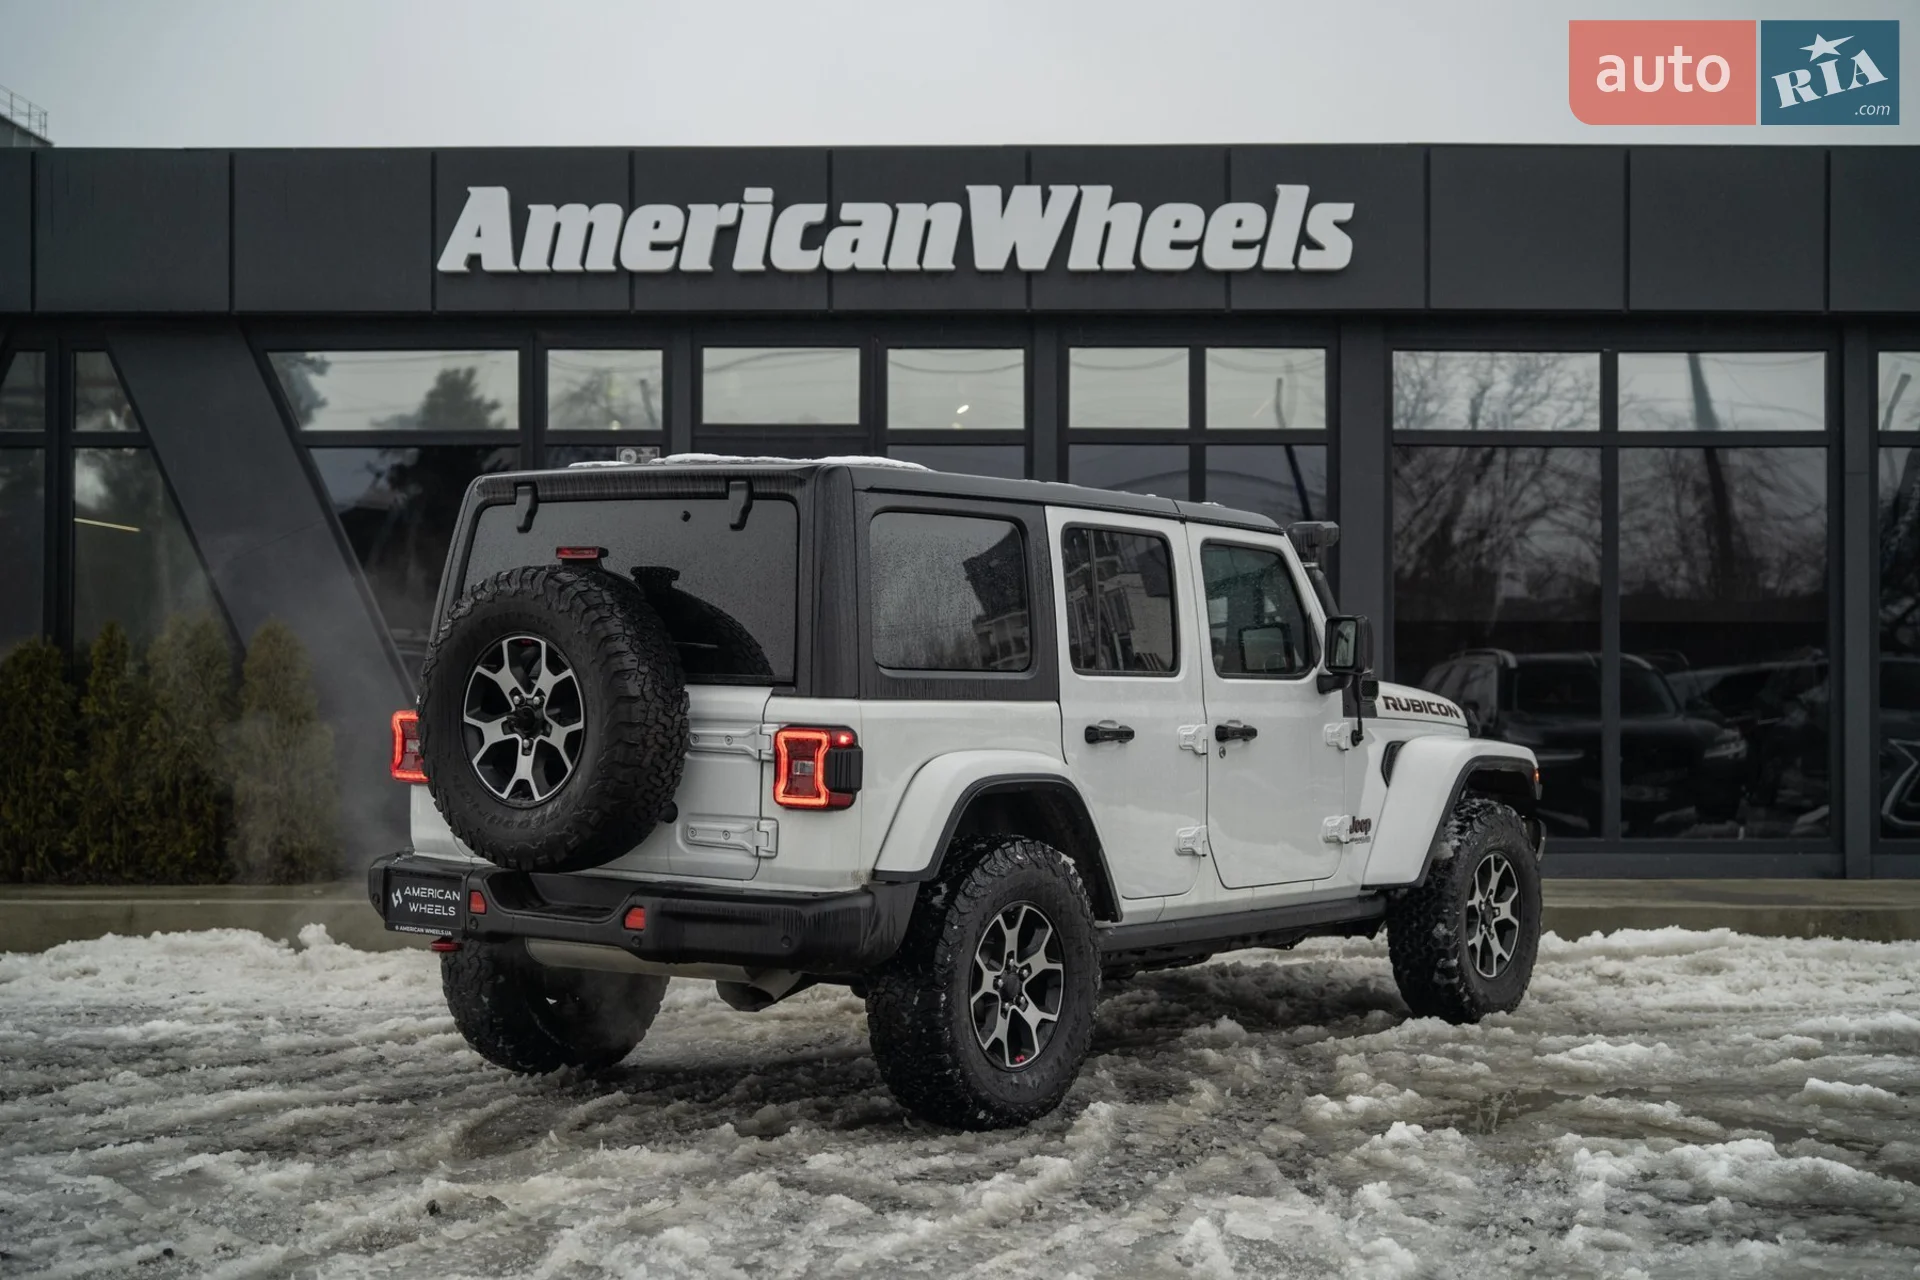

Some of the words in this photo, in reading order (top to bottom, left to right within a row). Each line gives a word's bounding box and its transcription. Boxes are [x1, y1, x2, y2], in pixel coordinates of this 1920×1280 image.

[437, 184, 1355, 272] AmericanWheels
[1382, 695, 1460, 719] RUBICON
[403, 886, 460, 901] AMERICAN
[409, 902, 456, 916] WHEELS
